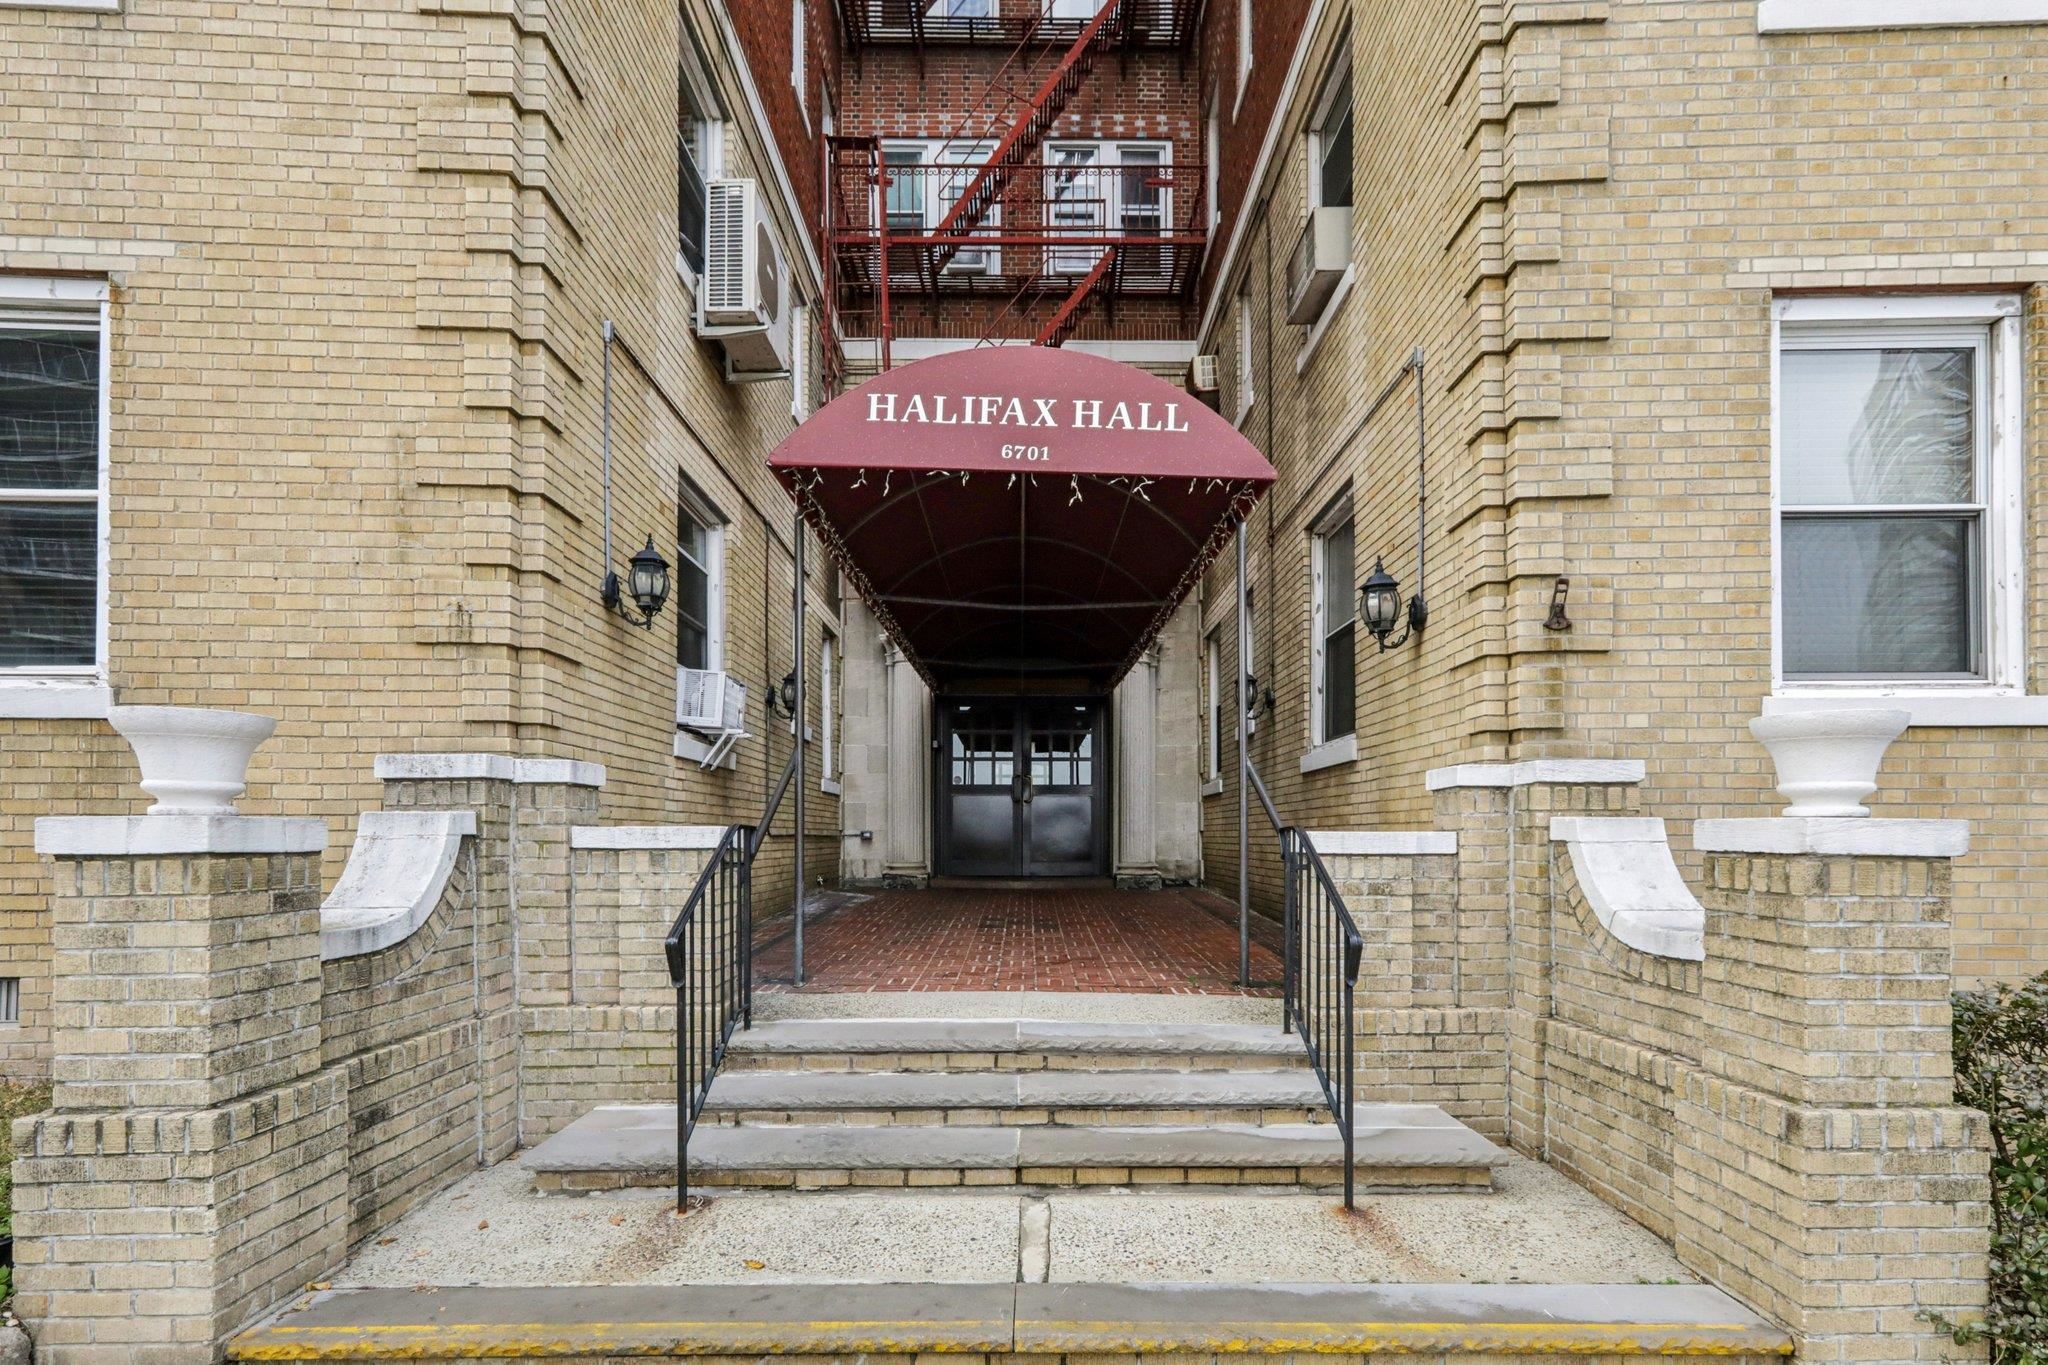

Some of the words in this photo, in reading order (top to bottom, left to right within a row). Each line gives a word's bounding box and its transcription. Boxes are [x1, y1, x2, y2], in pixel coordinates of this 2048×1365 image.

[866, 393, 1058, 427] HALIFAX
[1072, 400, 1189, 432] HALL
[1001, 444, 1050, 461] 6701
